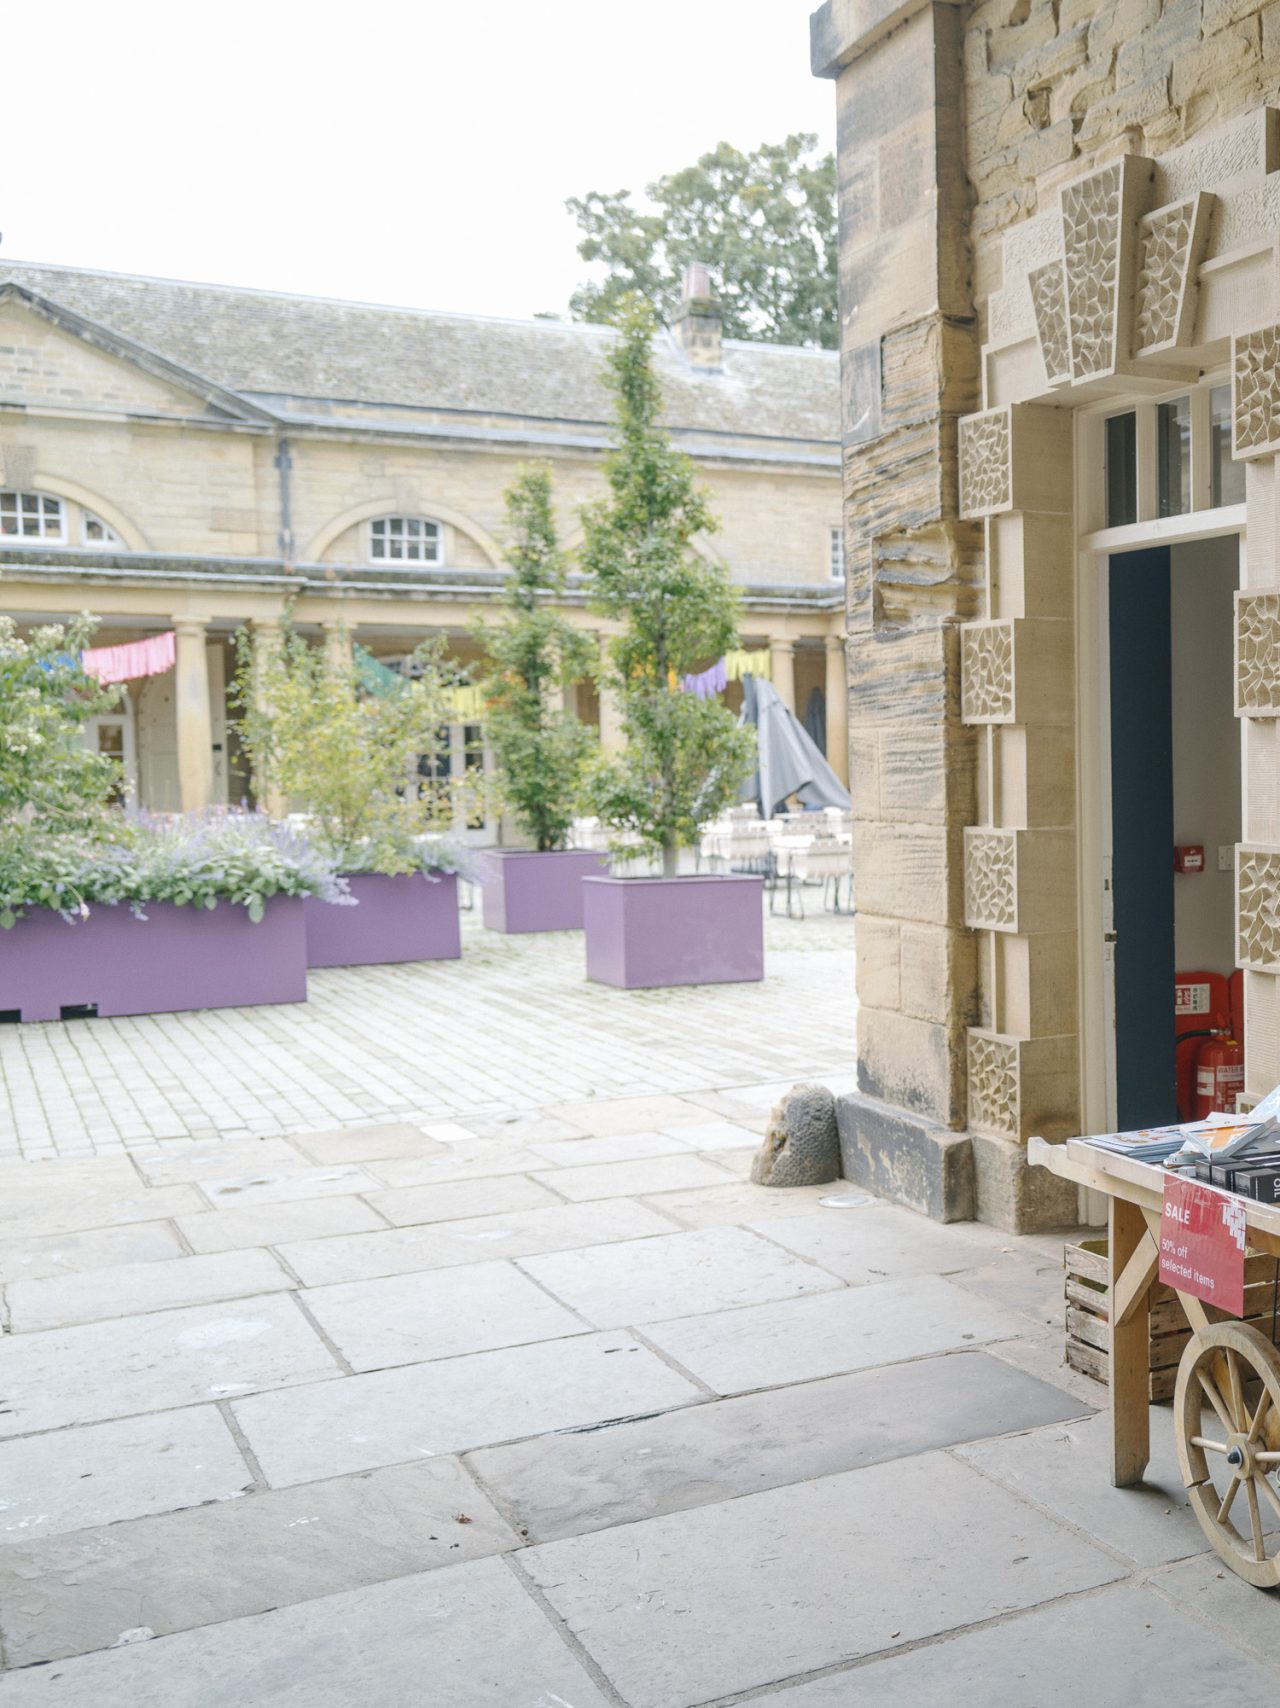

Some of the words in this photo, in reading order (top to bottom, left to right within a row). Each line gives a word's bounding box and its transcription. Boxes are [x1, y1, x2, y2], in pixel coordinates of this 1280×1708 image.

[1165, 1202, 1190, 1225] SALE
[1161, 1238, 1176, 1255] 50%
[1178, 1245, 1188, 1259] off
[1161, 1258, 1192, 1279] selected
[1193, 1269, 1215, 1289] items
